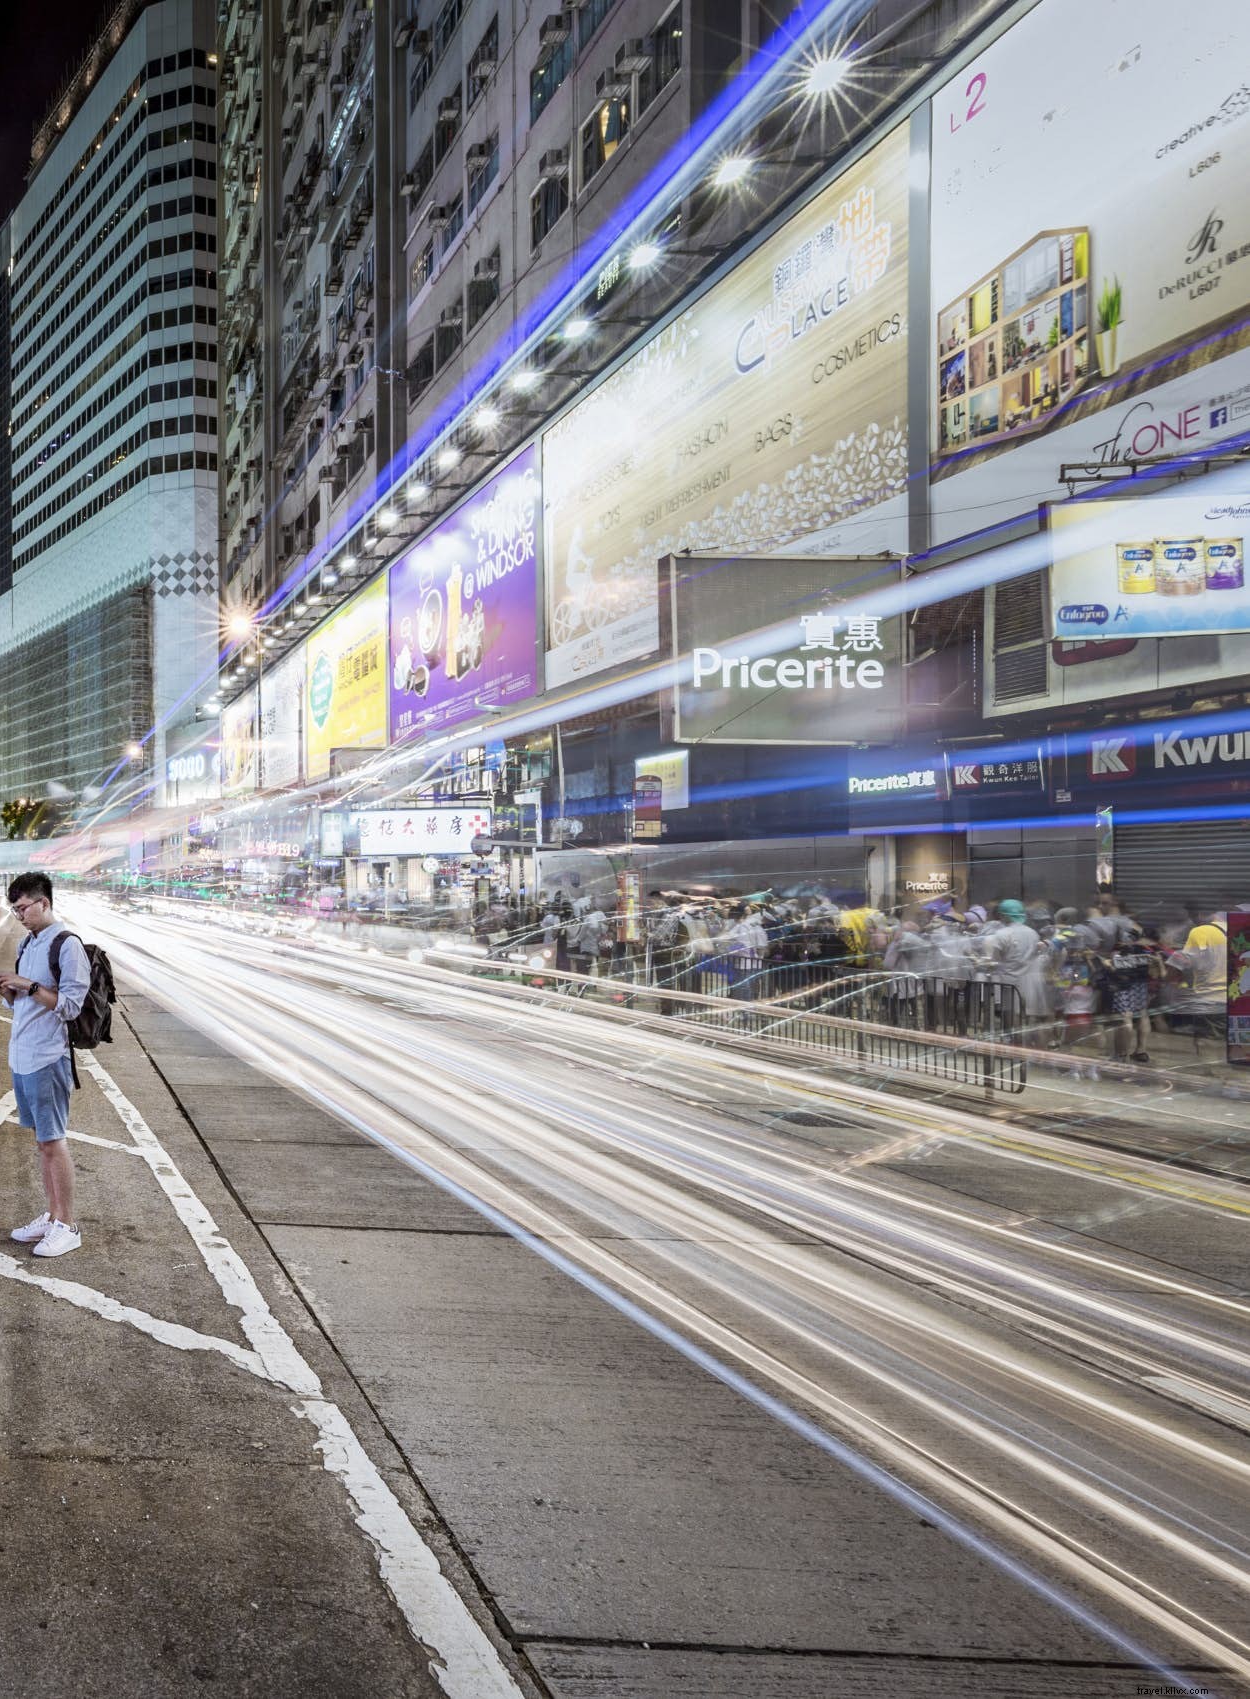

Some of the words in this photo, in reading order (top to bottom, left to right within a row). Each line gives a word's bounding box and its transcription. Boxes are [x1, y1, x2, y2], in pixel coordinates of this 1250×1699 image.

[812, 312, 901, 385] COSMETICS
[754, 412, 793, 453] BAGS
[1132, 405, 1201, 456] ONE
[476, 531, 535, 592] WINDSOR
[800, 611, 884, 652] 實惠
[693, 647, 885, 689] Pricerite
[983, 761, 1038, 777] 觀奇洋服
[1153, 729, 1250, 769] Kwu
[849, 774, 909, 793] Pricerite
[983, 776, 1004, 784] Kwun
[1004, 775, 1018, 783] Kee
